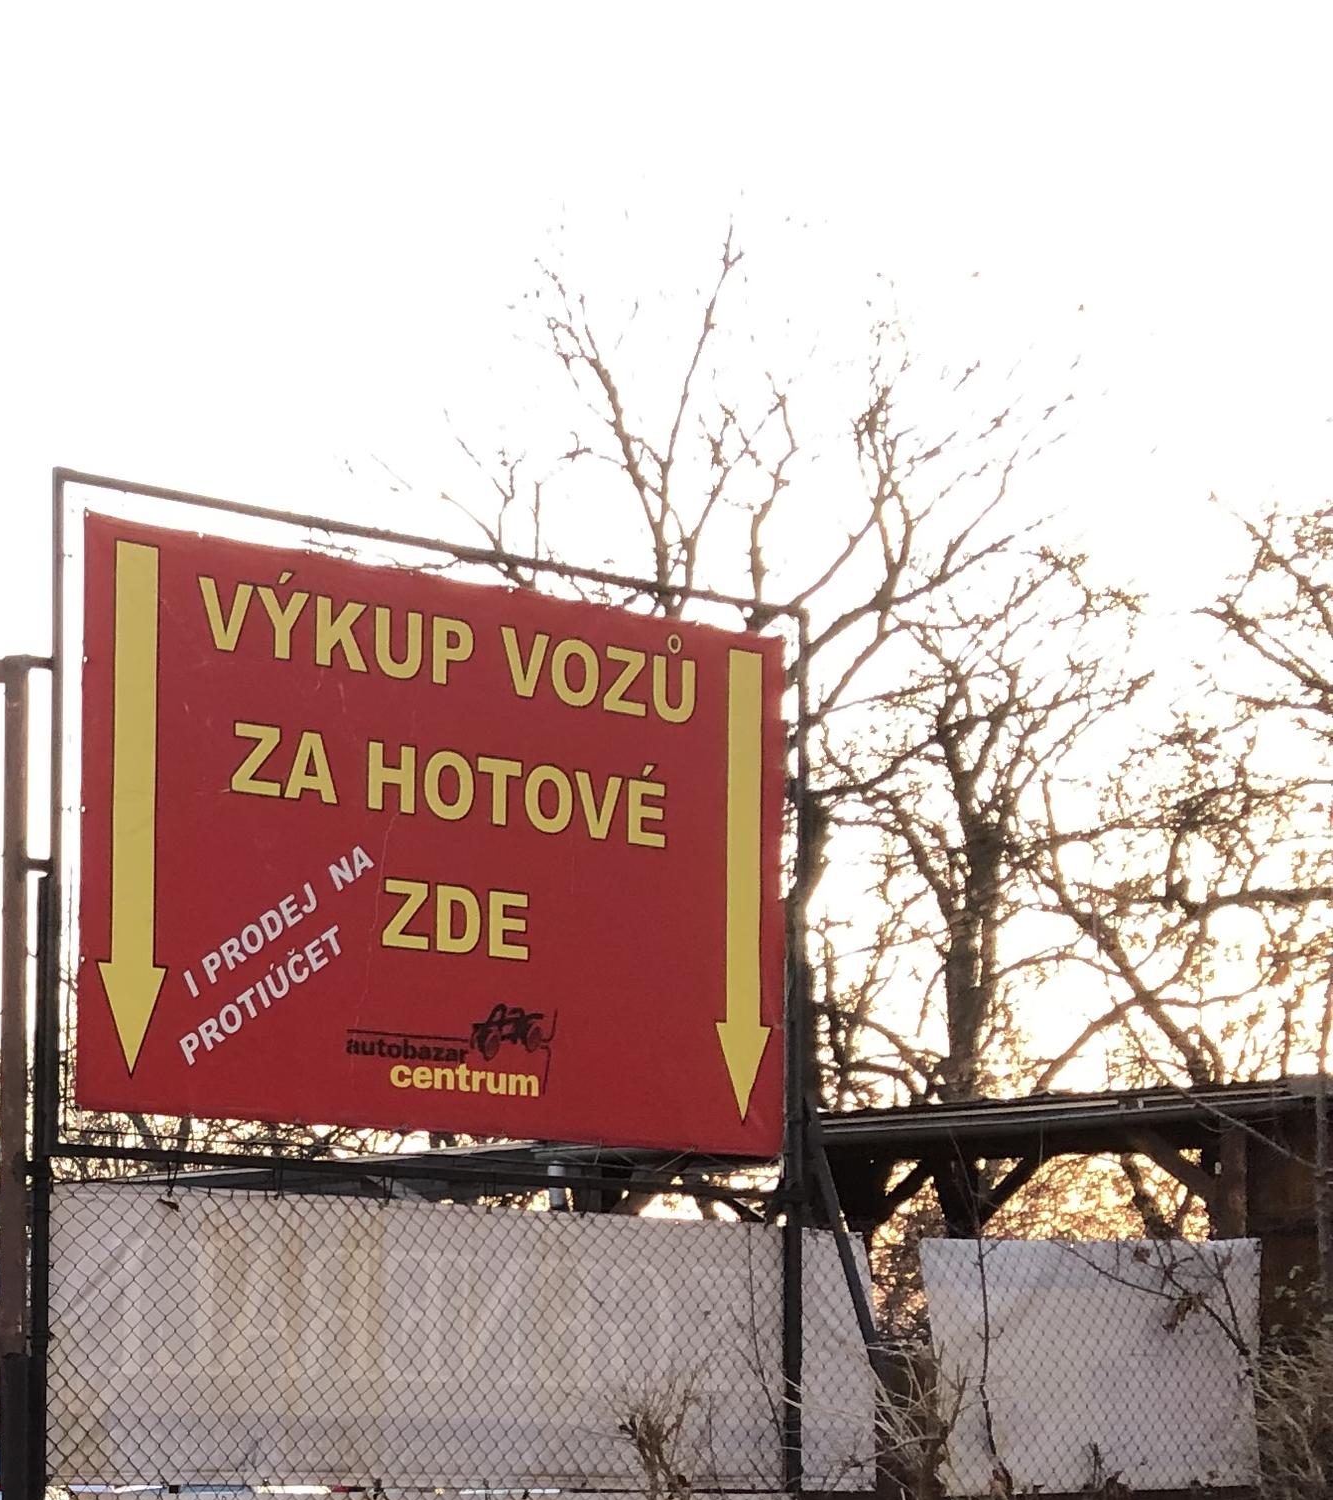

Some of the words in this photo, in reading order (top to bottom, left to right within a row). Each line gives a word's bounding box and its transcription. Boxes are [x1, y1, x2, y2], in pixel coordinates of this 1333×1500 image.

[197, 572, 475, 686] VÝKUP
[500, 626, 697, 724] VOZŮ
[229, 720, 339, 805] ZA
[366, 740, 668, 849] HOTOVÉ
[183, 969, 200, 998] I
[201, 882, 318, 985] PRODEJ
[328, 845, 375, 891] NA
[380, 878, 531, 962] ZDE
[179, 925, 342, 1066] PROTIÚČET
[345, 1038, 469, 1063] autobazar
[389, 1063, 540, 1097] centrum
